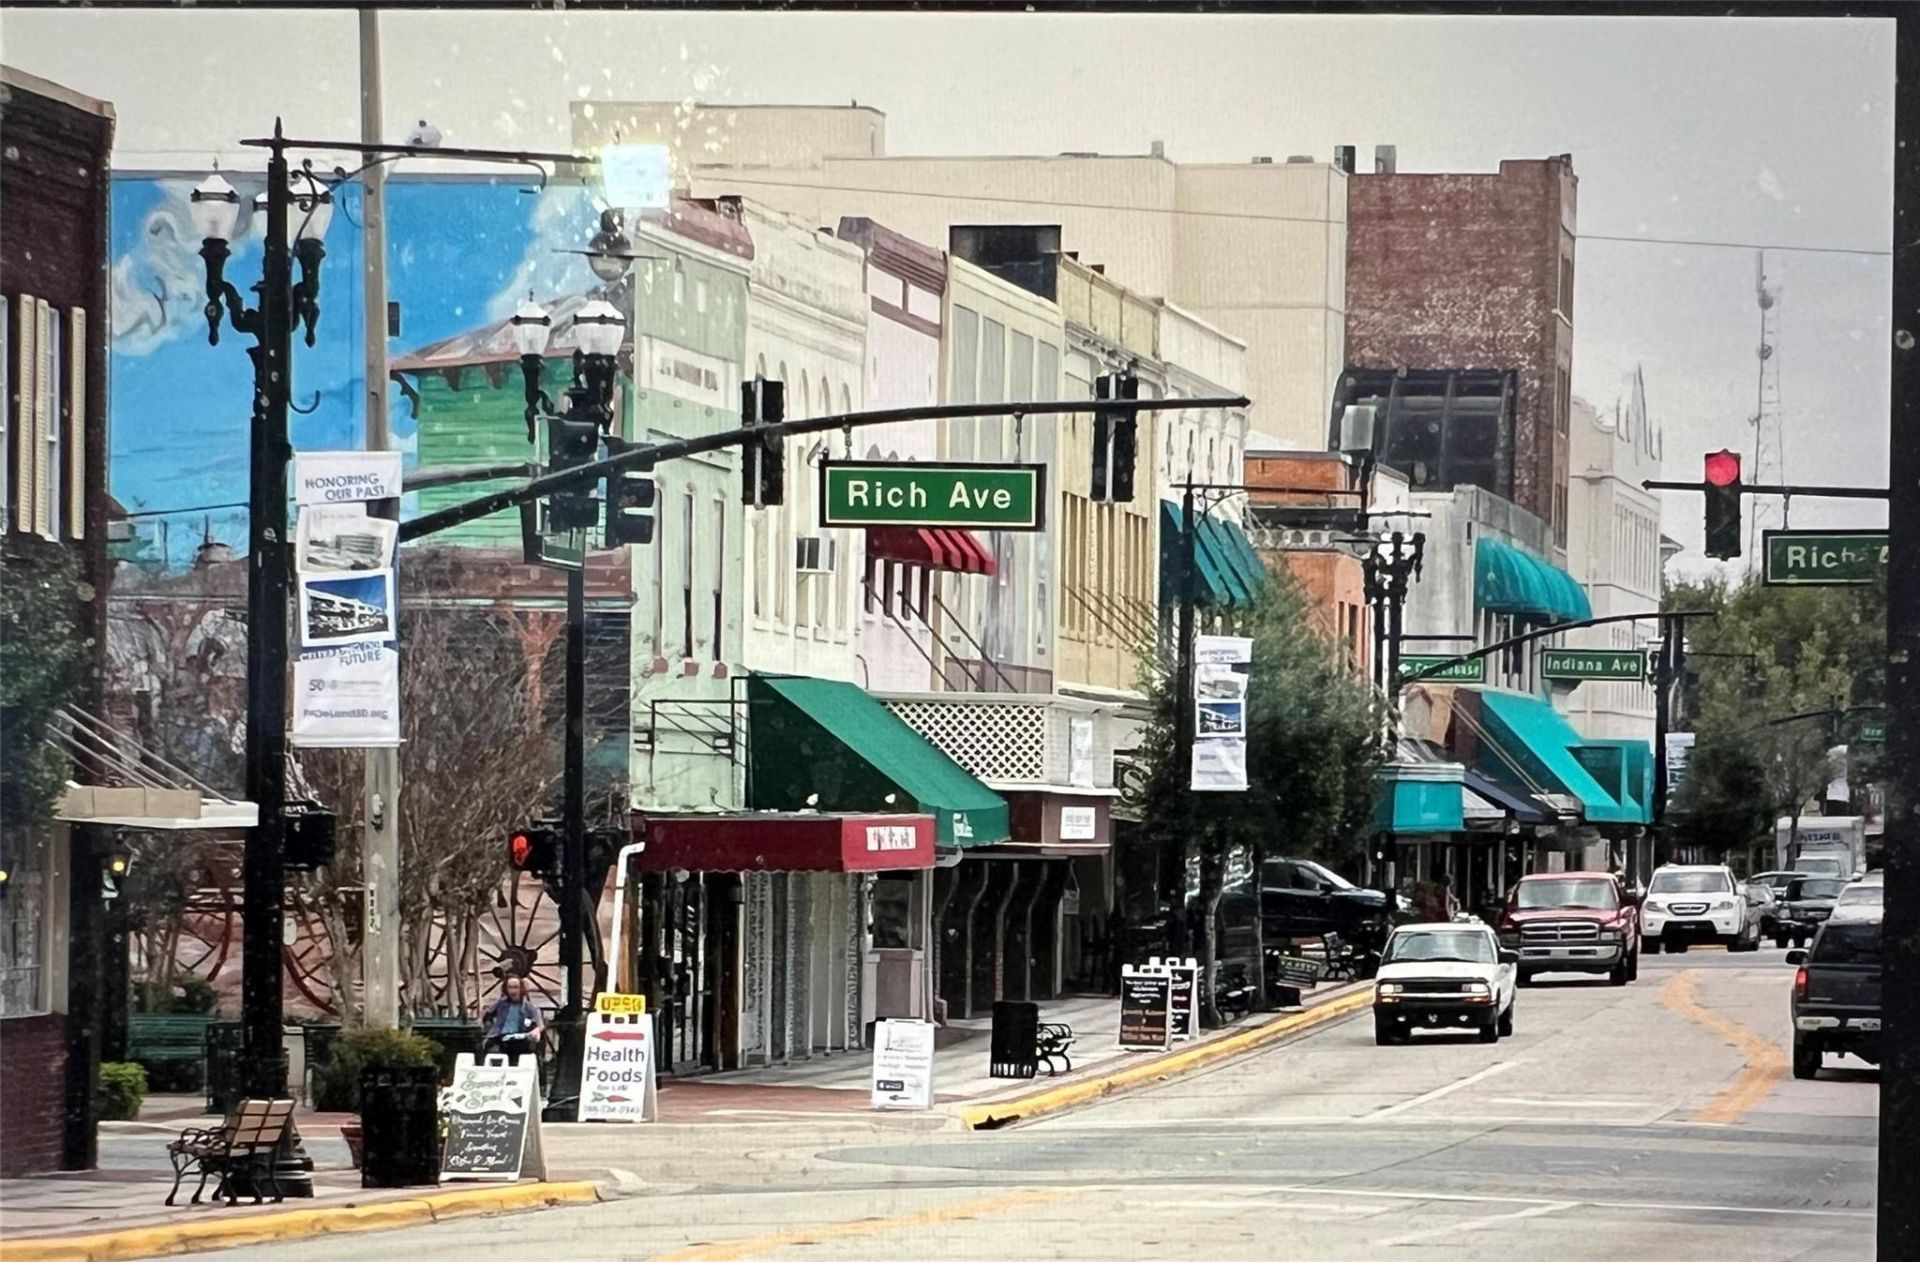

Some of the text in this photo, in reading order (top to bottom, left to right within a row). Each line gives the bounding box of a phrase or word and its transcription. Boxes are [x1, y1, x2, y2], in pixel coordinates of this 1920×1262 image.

[305, 473, 379, 489] HONORING
[325, 485, 385, 501] OUR PAST
[848, 480, 1012, 509] Rich Ave
[339, 650, 382, 667] FUTURE
[1547, 656, 1638, 673] Indiana Ave
[587, 1047, 645, 1062] Health
[586, 1067, 643, 1083] Foods
